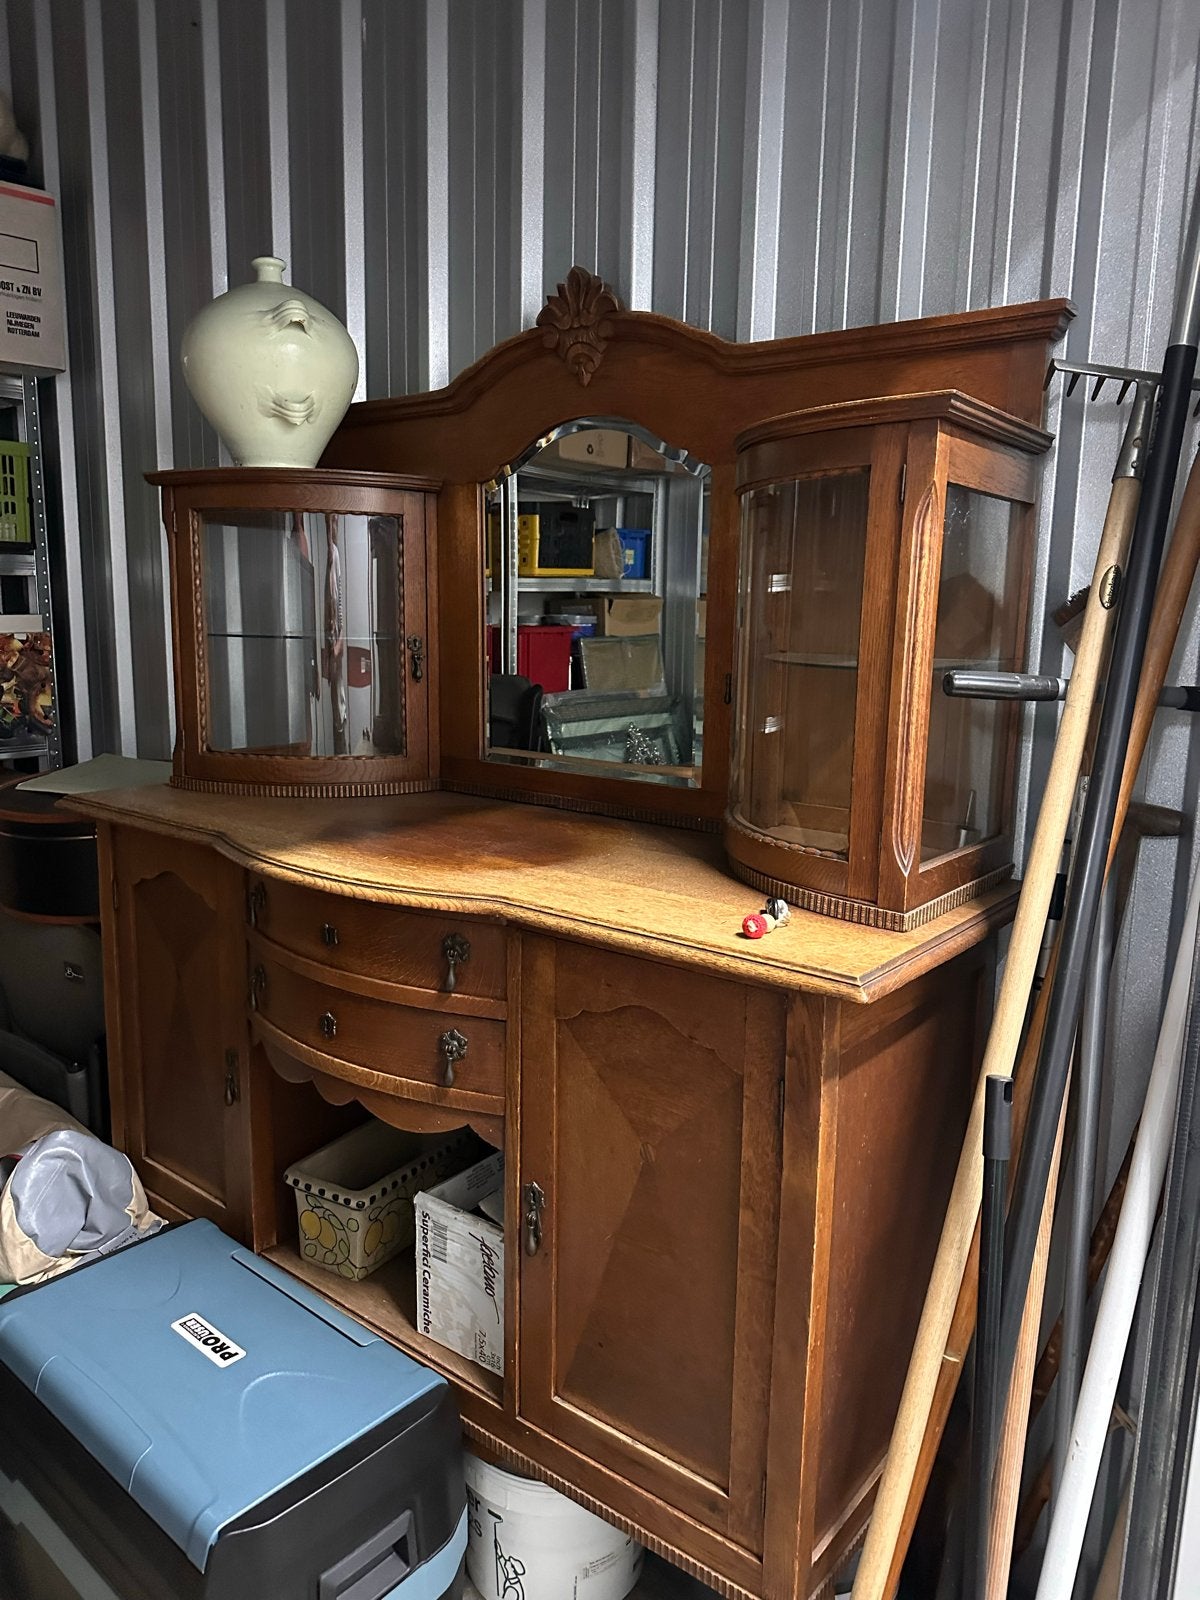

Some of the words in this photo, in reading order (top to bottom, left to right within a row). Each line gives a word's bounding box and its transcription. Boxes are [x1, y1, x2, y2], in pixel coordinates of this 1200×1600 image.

[0, 281, 14, 291] OST
[33, 287, 41, 296] BV
[6, 311, 41, 323] LEEUWARDEN
[6, 319, 35, 330] NIJMEGEN
[7, 327, 40, 337] ROTTERDAM
[420, 1210, 431, 1268] Superfici
[421, 1269, 432, 1334] Ceramiche
[478, 1329, 487, 1363] 7,5x40
